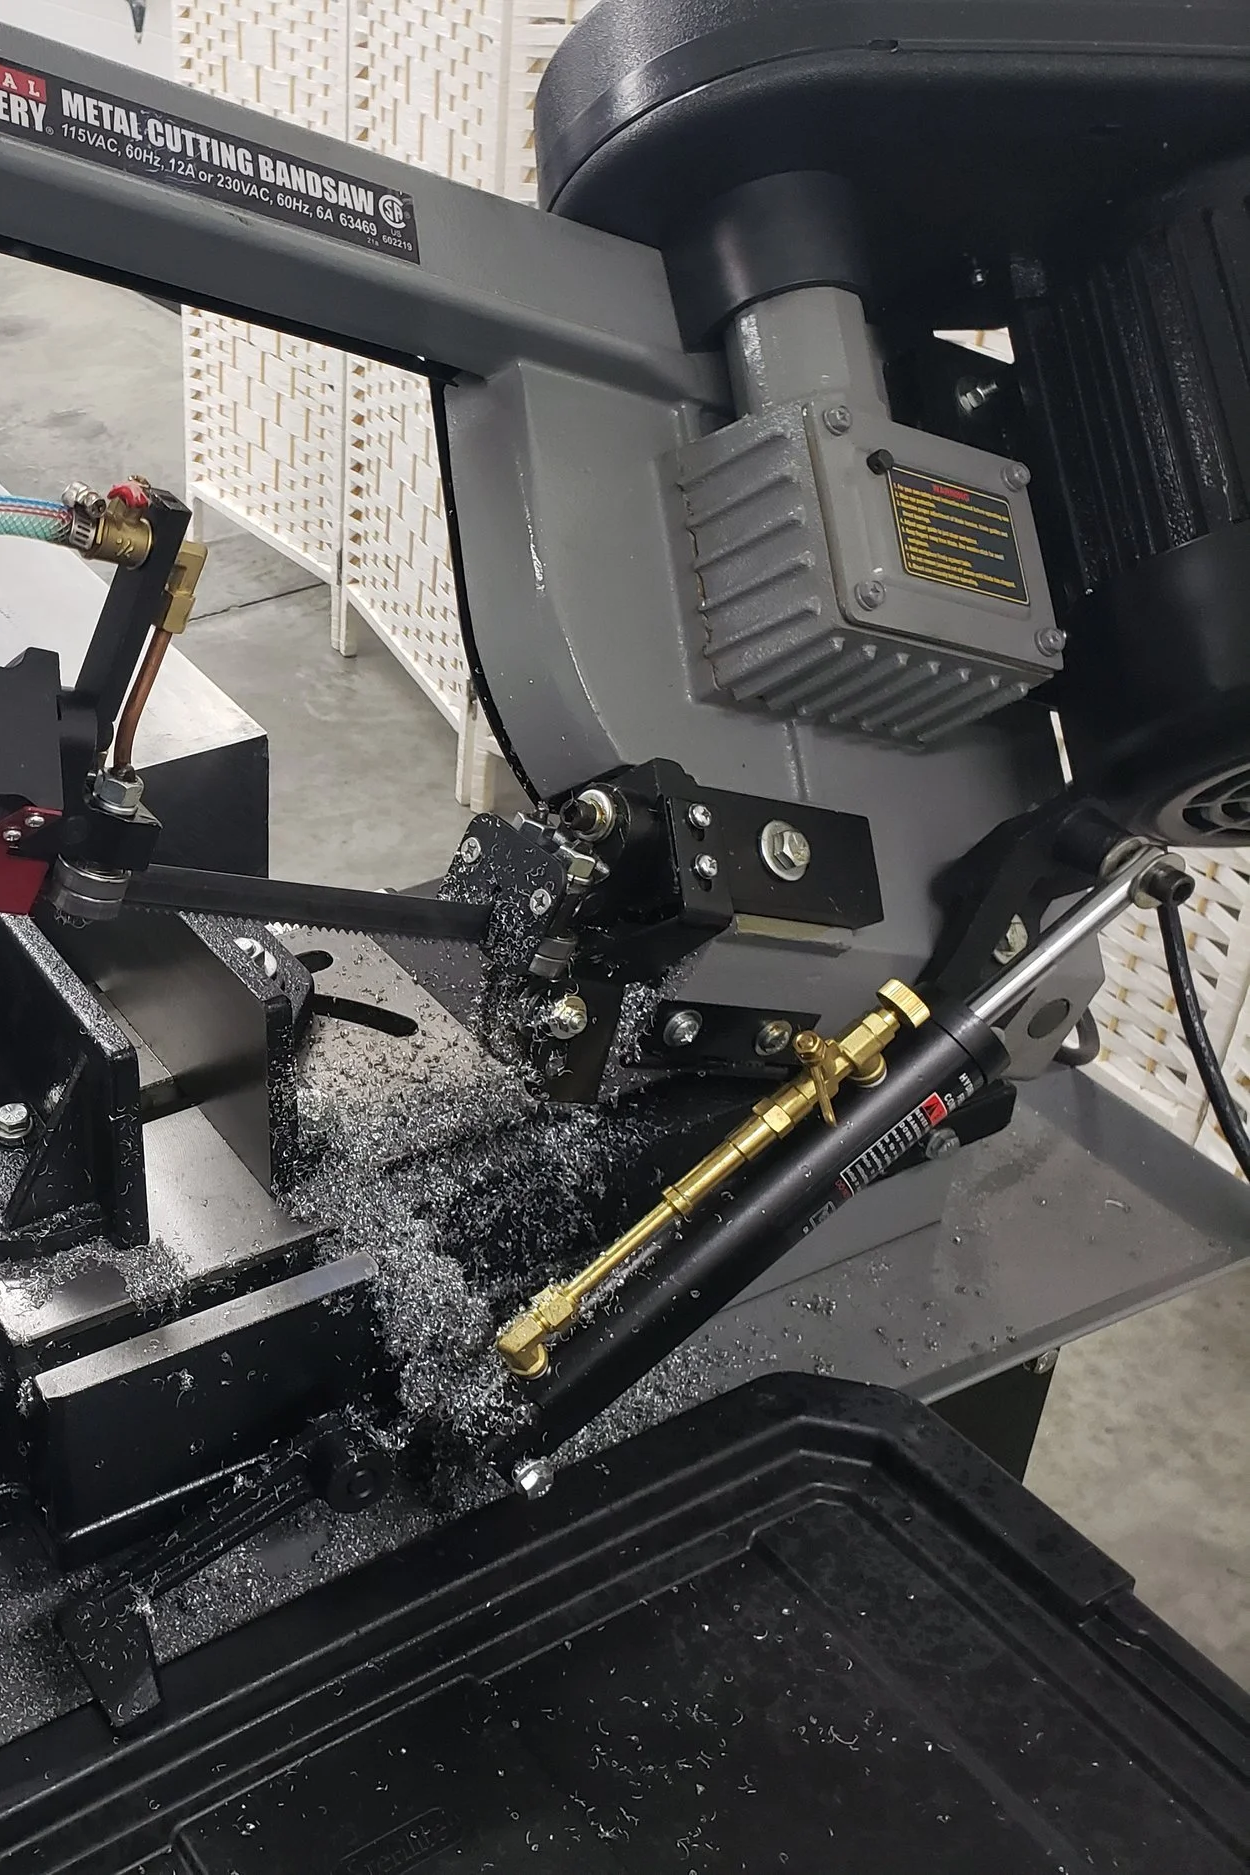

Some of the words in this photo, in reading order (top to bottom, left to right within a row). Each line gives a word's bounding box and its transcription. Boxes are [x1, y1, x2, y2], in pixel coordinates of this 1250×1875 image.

[61, 88, 143, 141] METAL
[147, 118, 254, 177] CUTTING
[258, 154, 374, 217] BANDSAW
[61, 123, 121, 157] 115VAC,
[125, 143, 165, 171] 60Hz,
[169, 157, 196, 179] 12A
[198, 170, 214, 183] or
[217, 173, 274, 206] 230VAC,
[276, 192, 313, 218] 60Hz,
[316, 205, 334, 223] 6A
[339, 212, 377, 237] 63469
[382, 234, 413, 251] 602219
